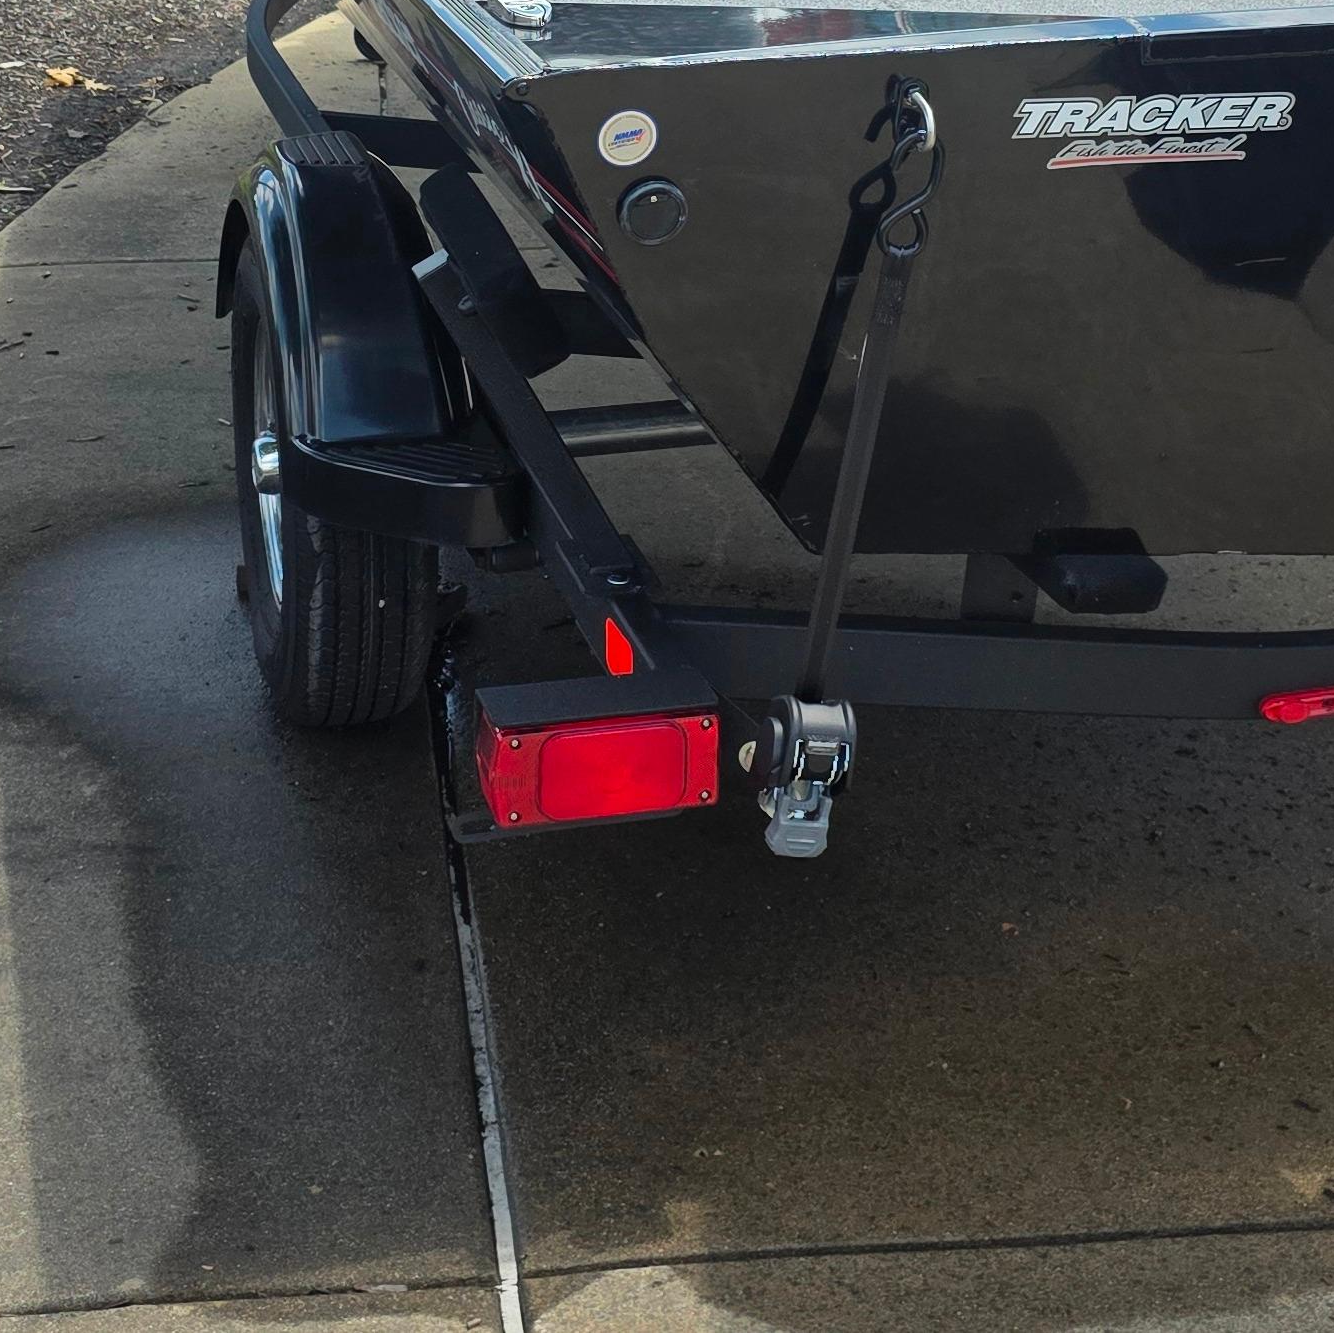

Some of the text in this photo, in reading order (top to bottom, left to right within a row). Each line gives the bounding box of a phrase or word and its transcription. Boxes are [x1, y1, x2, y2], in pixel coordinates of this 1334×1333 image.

[1015, 95, 1287, 137] TRACKER
[1063, 140, 1109, 159] Fish
[1110, 139, 1145, 157] the
